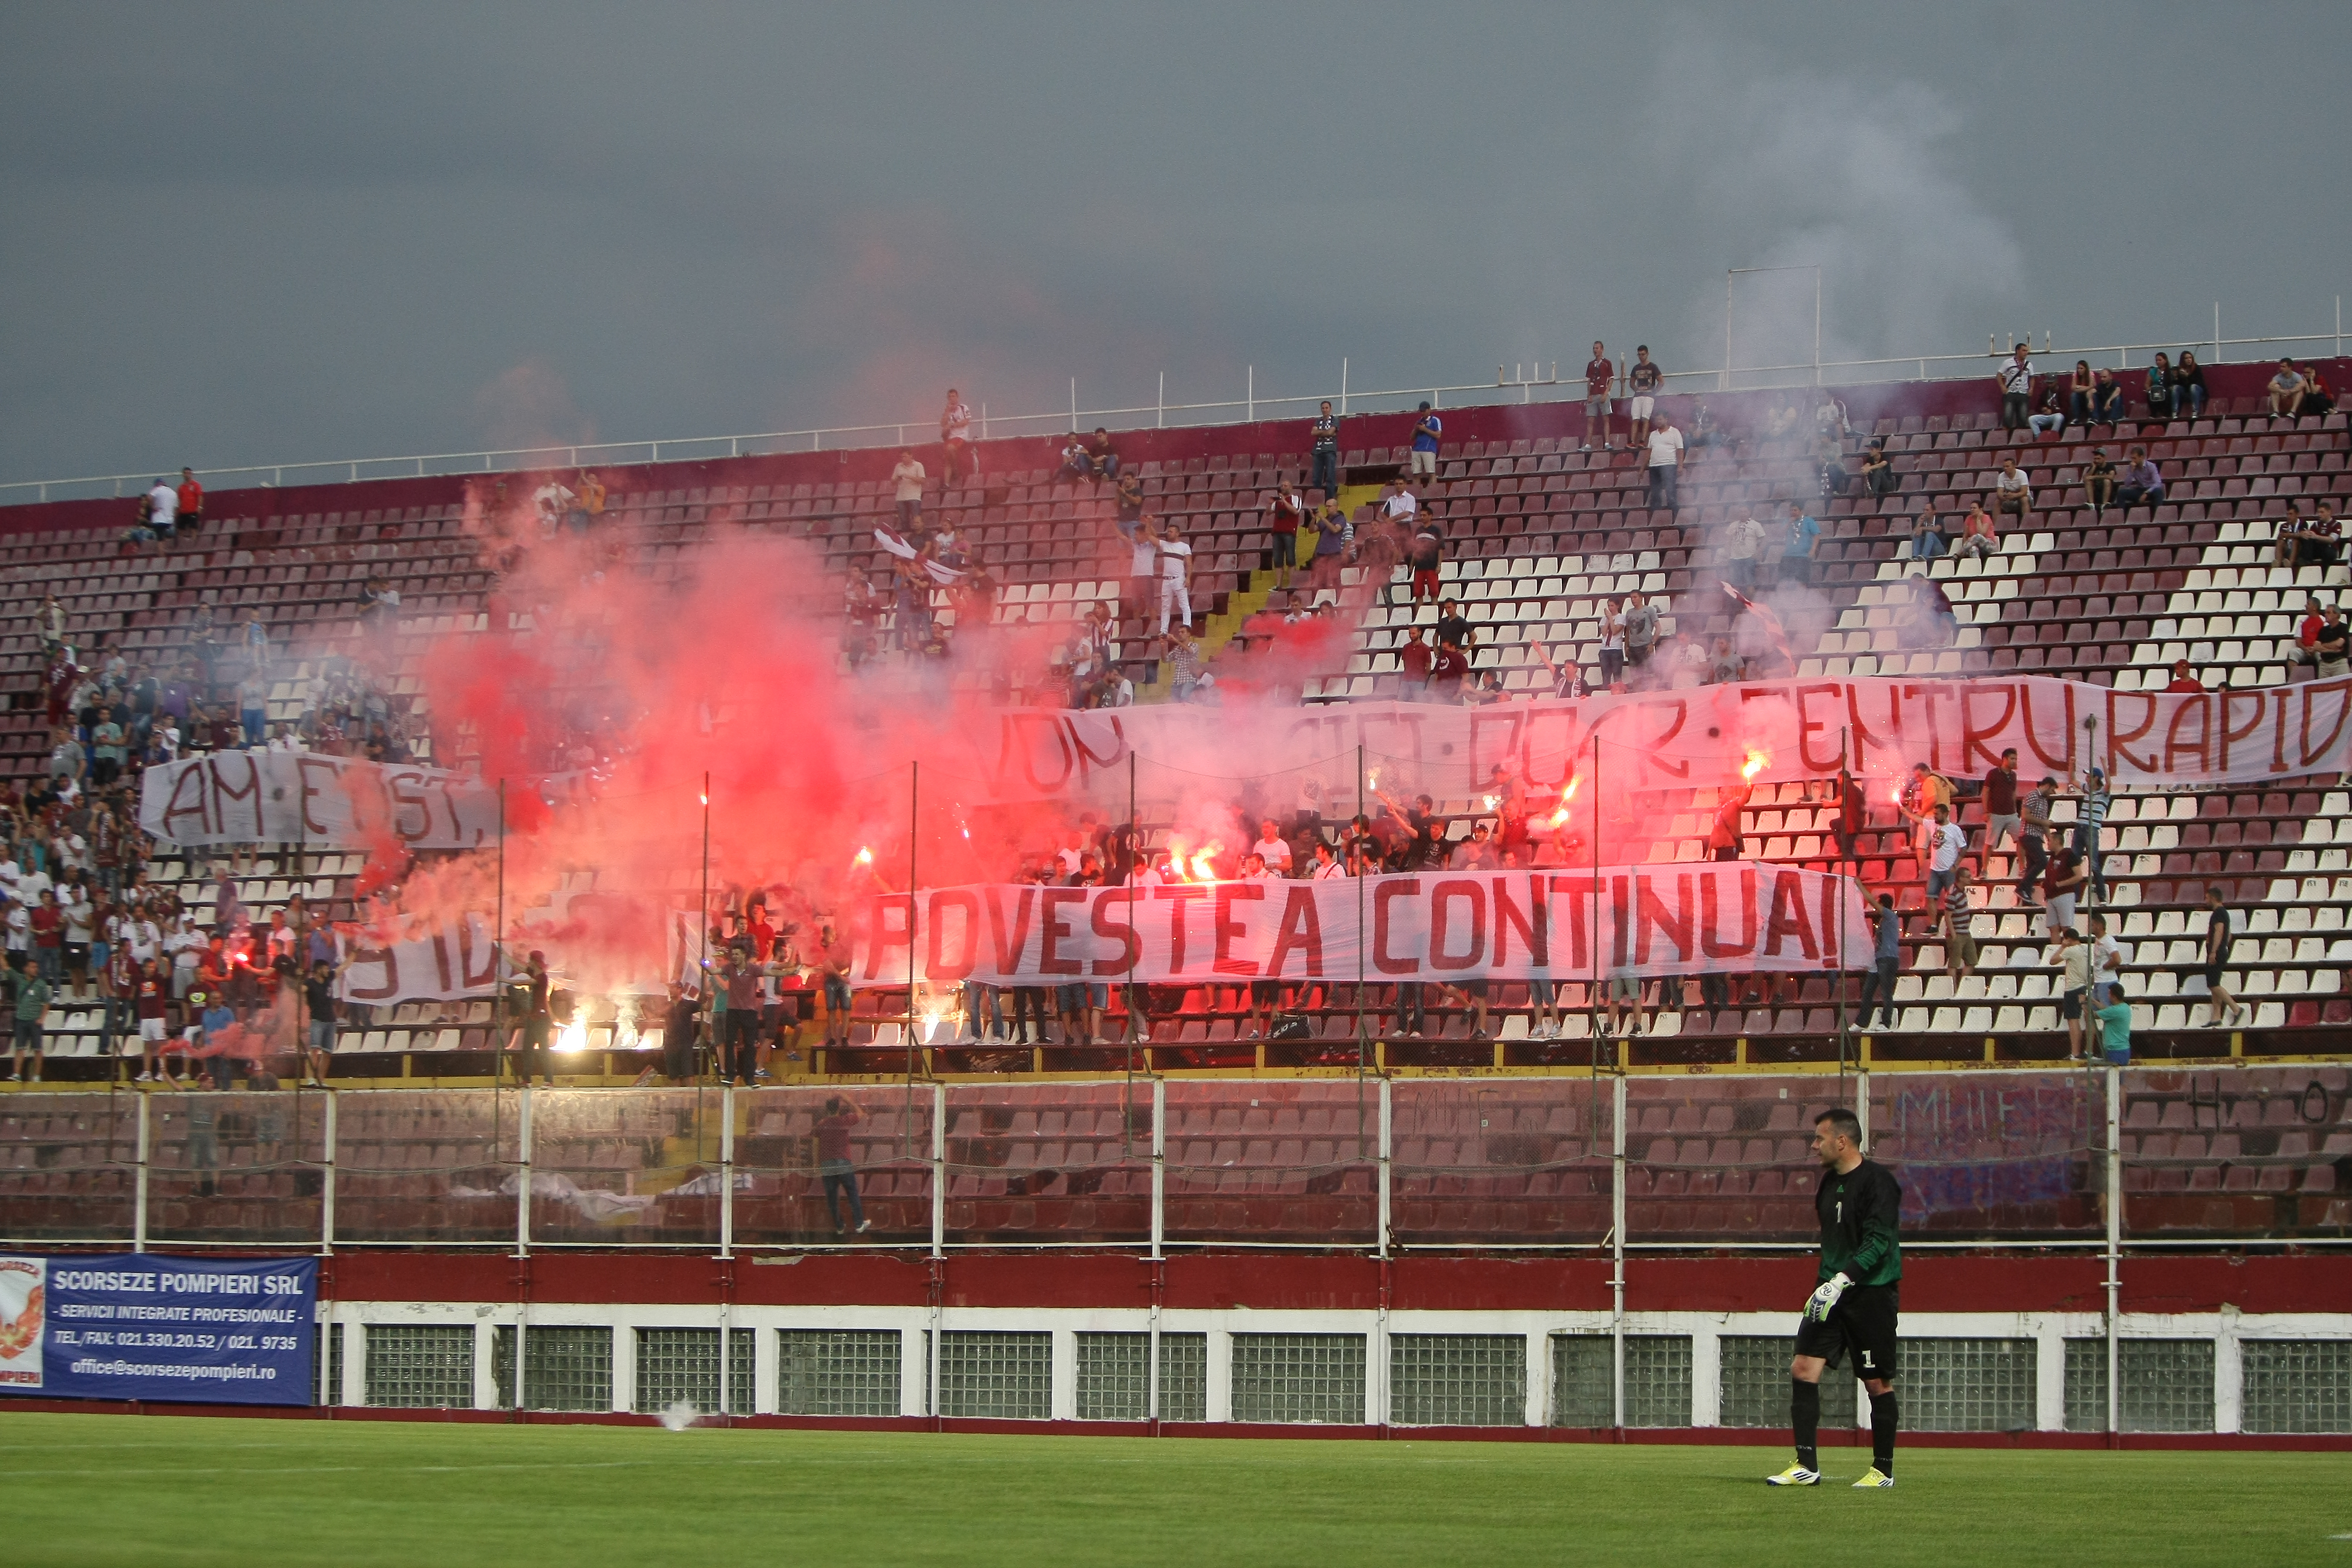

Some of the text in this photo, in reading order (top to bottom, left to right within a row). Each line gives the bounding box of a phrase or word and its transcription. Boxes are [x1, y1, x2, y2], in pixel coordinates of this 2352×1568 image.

[163, 756, 264, 837] AM
[2105, 678, 2352, 776] RAPID
[863, 884, 1324, 980] POVESTEA
[1372, 869, 1840, 975] CONTINUA!
[1835, 1201, 1843, 1224] 1
[54, 1271, 303, 1295] SCORSEZE POMPIERI SRL
[60, 1304, 296, 1323] SERVICII INTEGRATE PROFESIONALE
[117, 1332, 215, 1348] 021.330.20.52
[260, 1336, 298, 1350] 9735
[70, 1358, 276, 1382] office@scorsezepompieri.ro
[1861, 1350, 1876, 1369] 1
